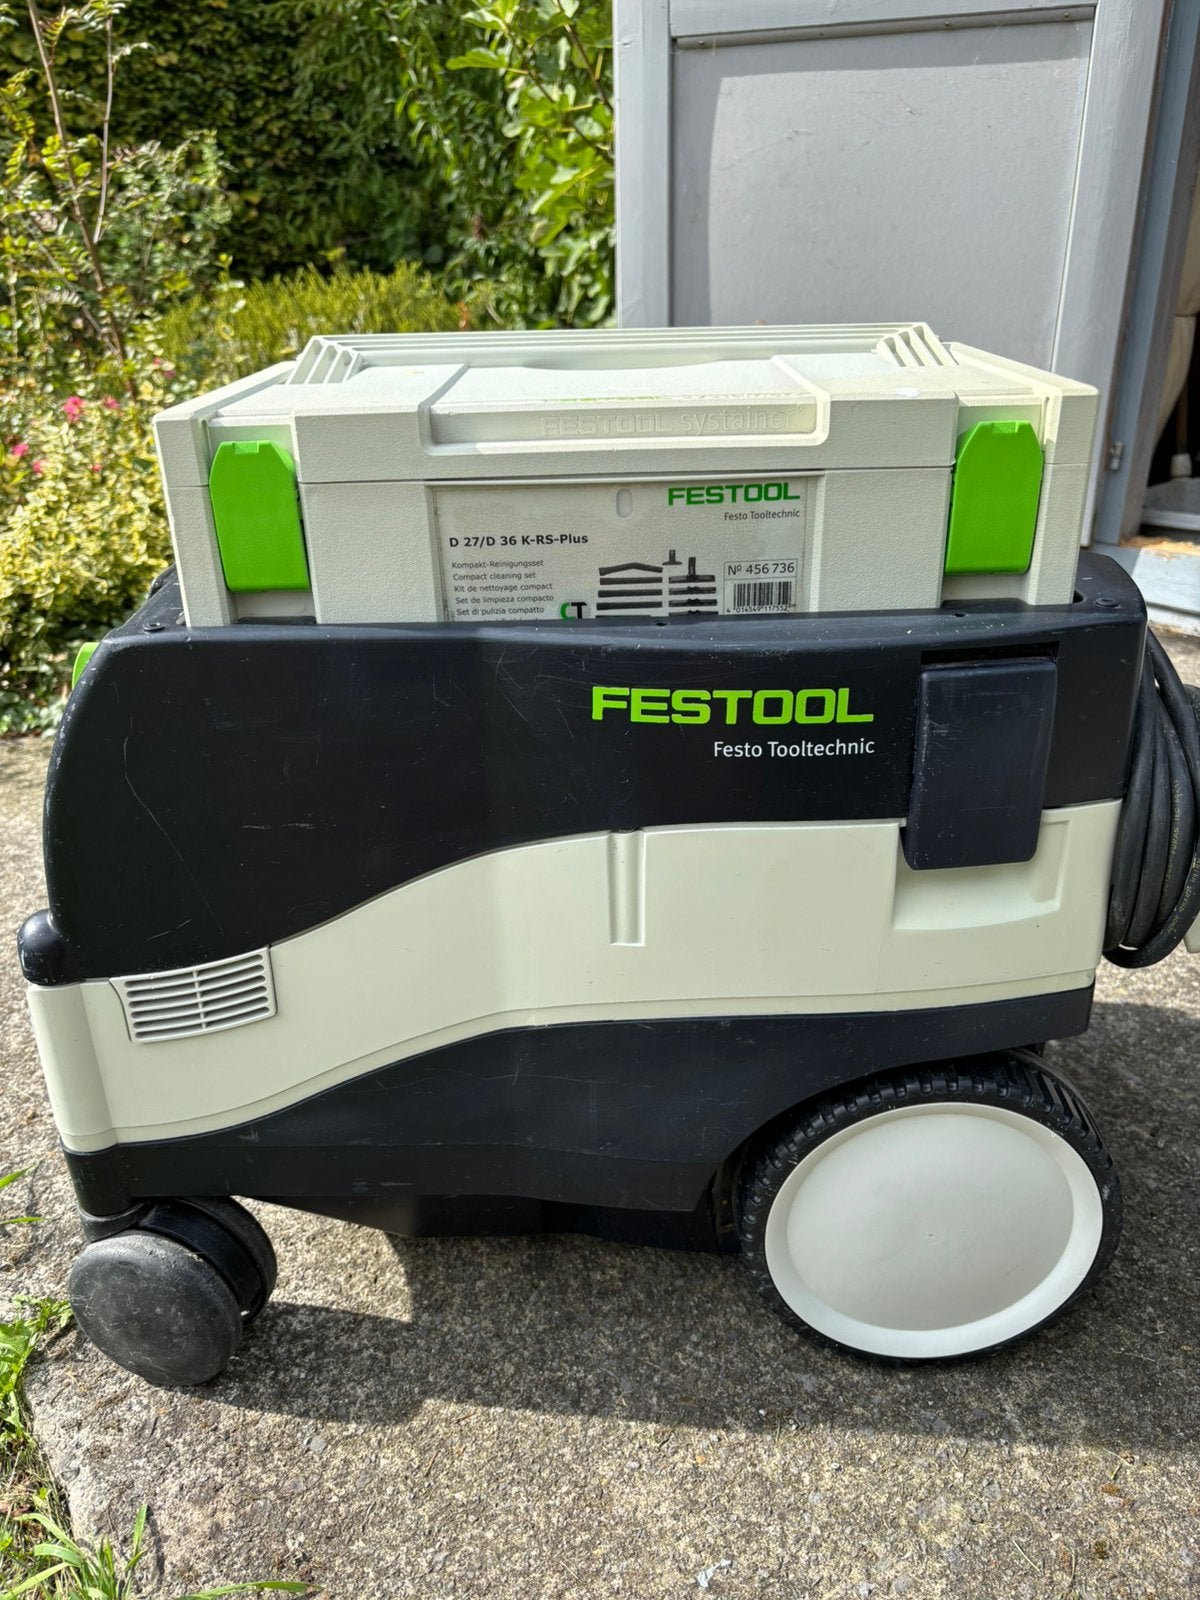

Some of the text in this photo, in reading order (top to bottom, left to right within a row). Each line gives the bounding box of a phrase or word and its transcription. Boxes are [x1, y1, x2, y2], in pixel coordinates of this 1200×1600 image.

[541, 414, 672, 437] FESTOOL
[668, 482, 800, 506] FESTOOL
[724, 509, 800, 521] Festo Tooltechnic
[449, 533, 589, 548] D 27/D 36 K-RS-Plus
[451, 560, 544, 569] Kompakt-Reinigungsset
[746, 563, 769, 575] 456
[772, 562, 795, 573] 736
[452, 571, 536, 581] Compact cleaning set
[467, 584, 477, 592] de
[479, 584, 518, 593] nettoyage
[520, 583, 553, 591] compact
[455, 594, 554, 605] Set de limpieza compacto
[456, 608, 469, 616] Set
[482, 607, 506, 616] pulizia
[508, 606, 544, 615] compatto
[592, 686, 874, 724] FESTOOL
[714, 738, 875, 757] Festo Tooltechnic
